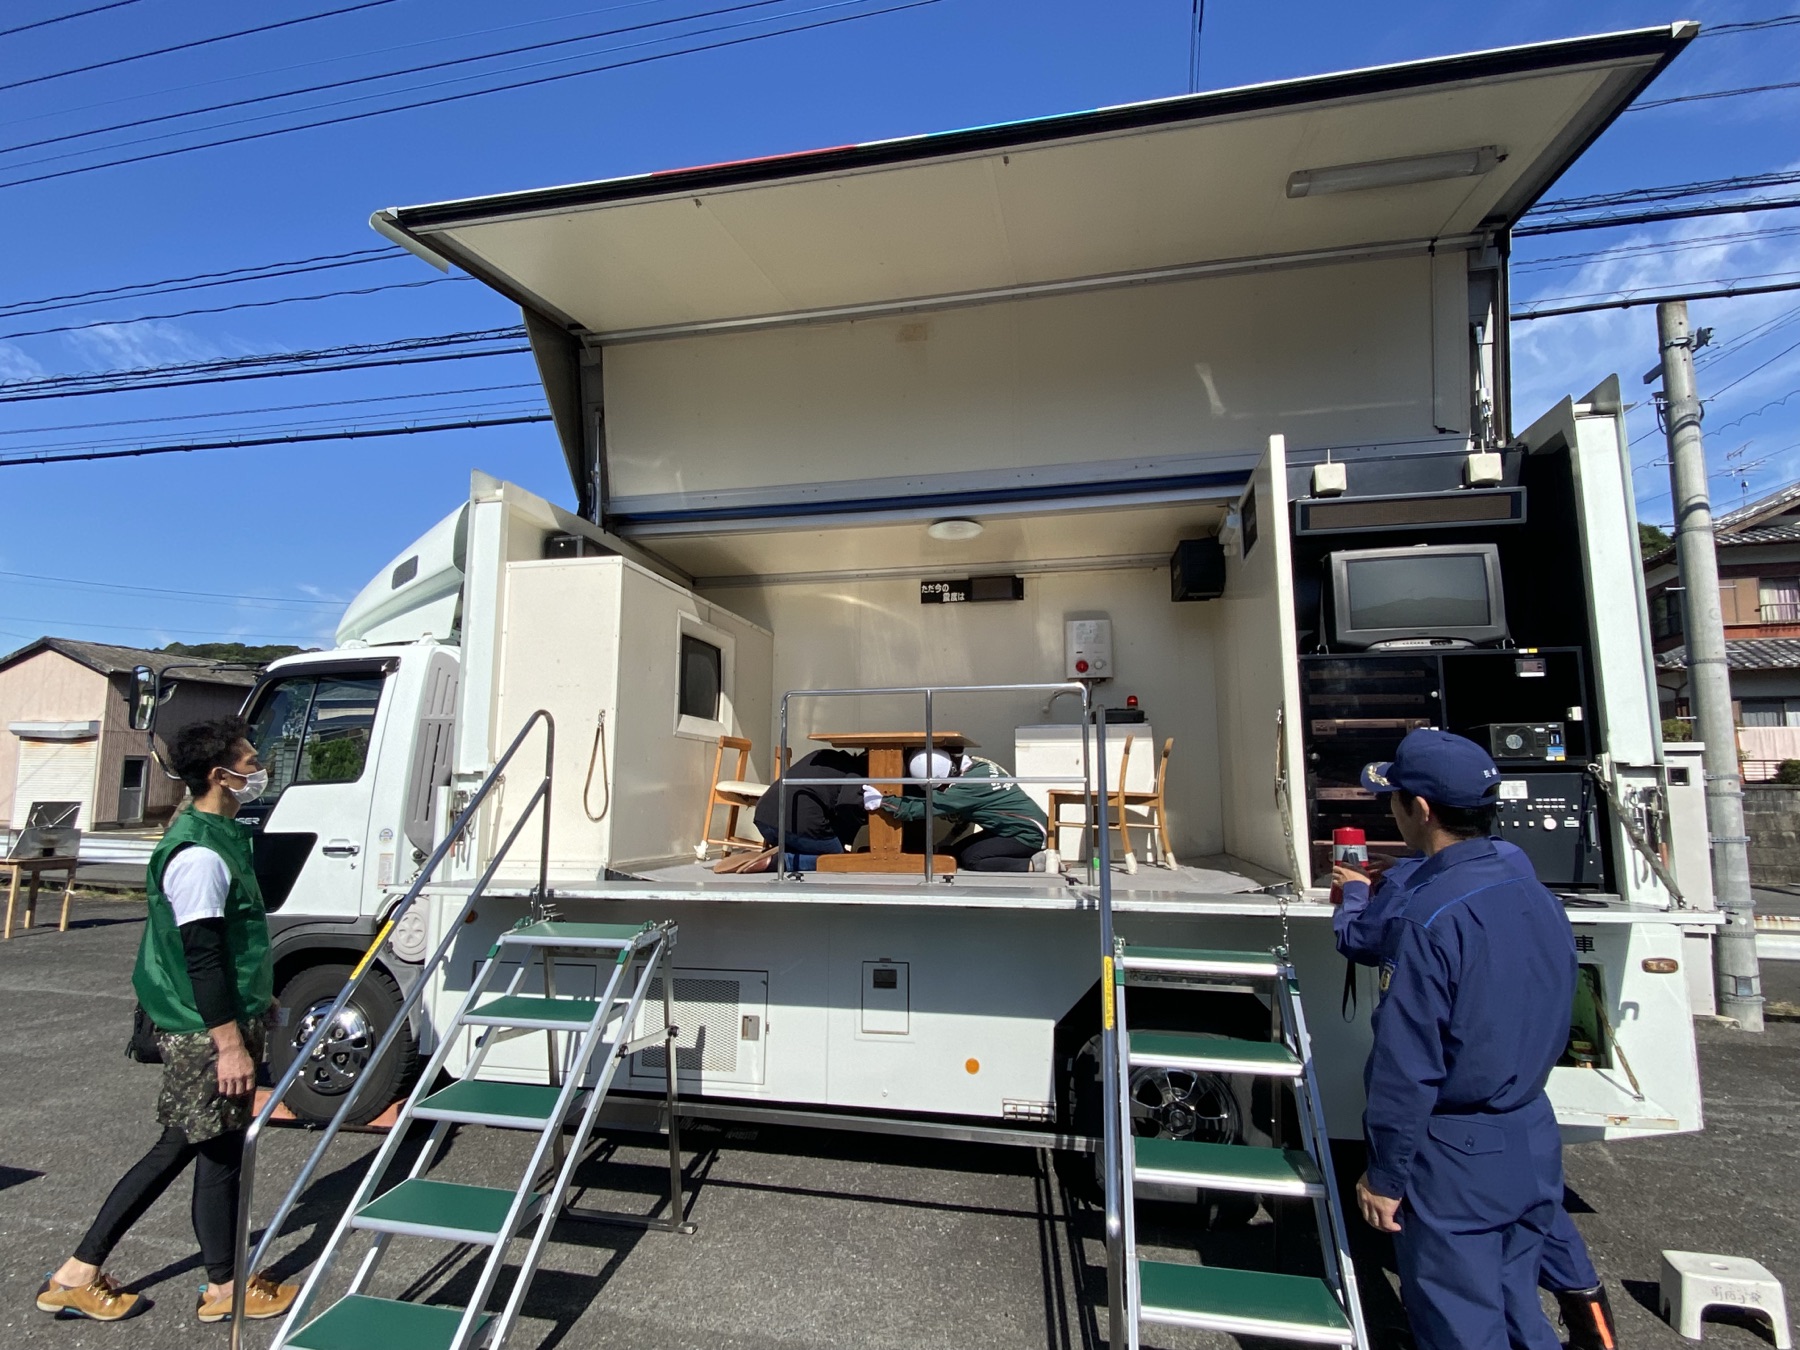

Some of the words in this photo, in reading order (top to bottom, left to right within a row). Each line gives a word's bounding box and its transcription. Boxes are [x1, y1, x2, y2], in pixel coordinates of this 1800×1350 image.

[921, 583, 949, 594] ただ今の
[942, 592, 965, 602] 震度は
